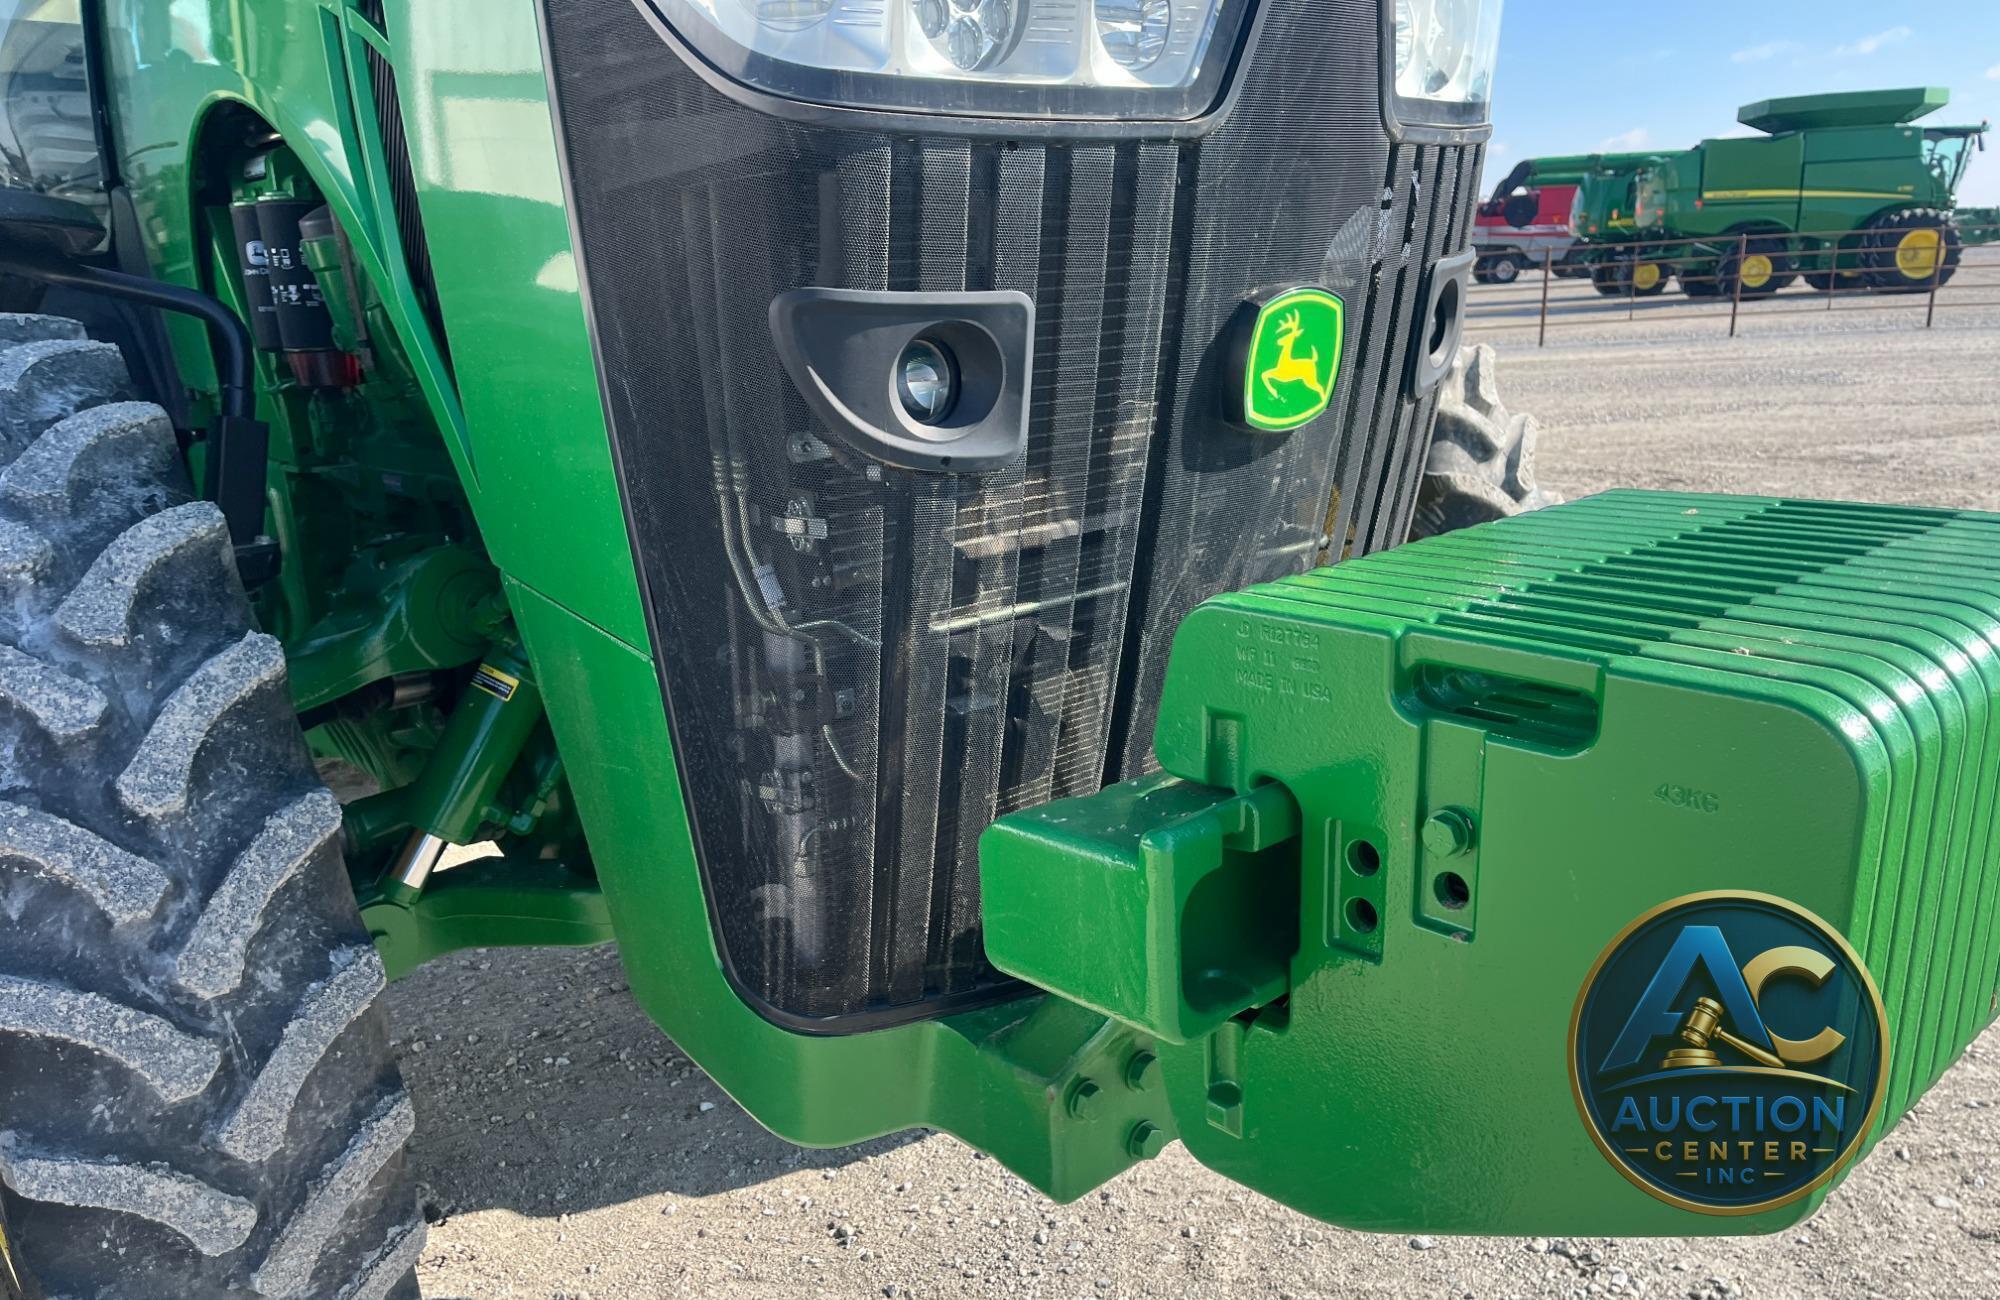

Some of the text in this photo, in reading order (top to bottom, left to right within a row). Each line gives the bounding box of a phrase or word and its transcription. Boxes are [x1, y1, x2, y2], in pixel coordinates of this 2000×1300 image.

[1235, 668, 1333, 702] MADE IN USA
[1654, 783, 1720, 813] 43KG
